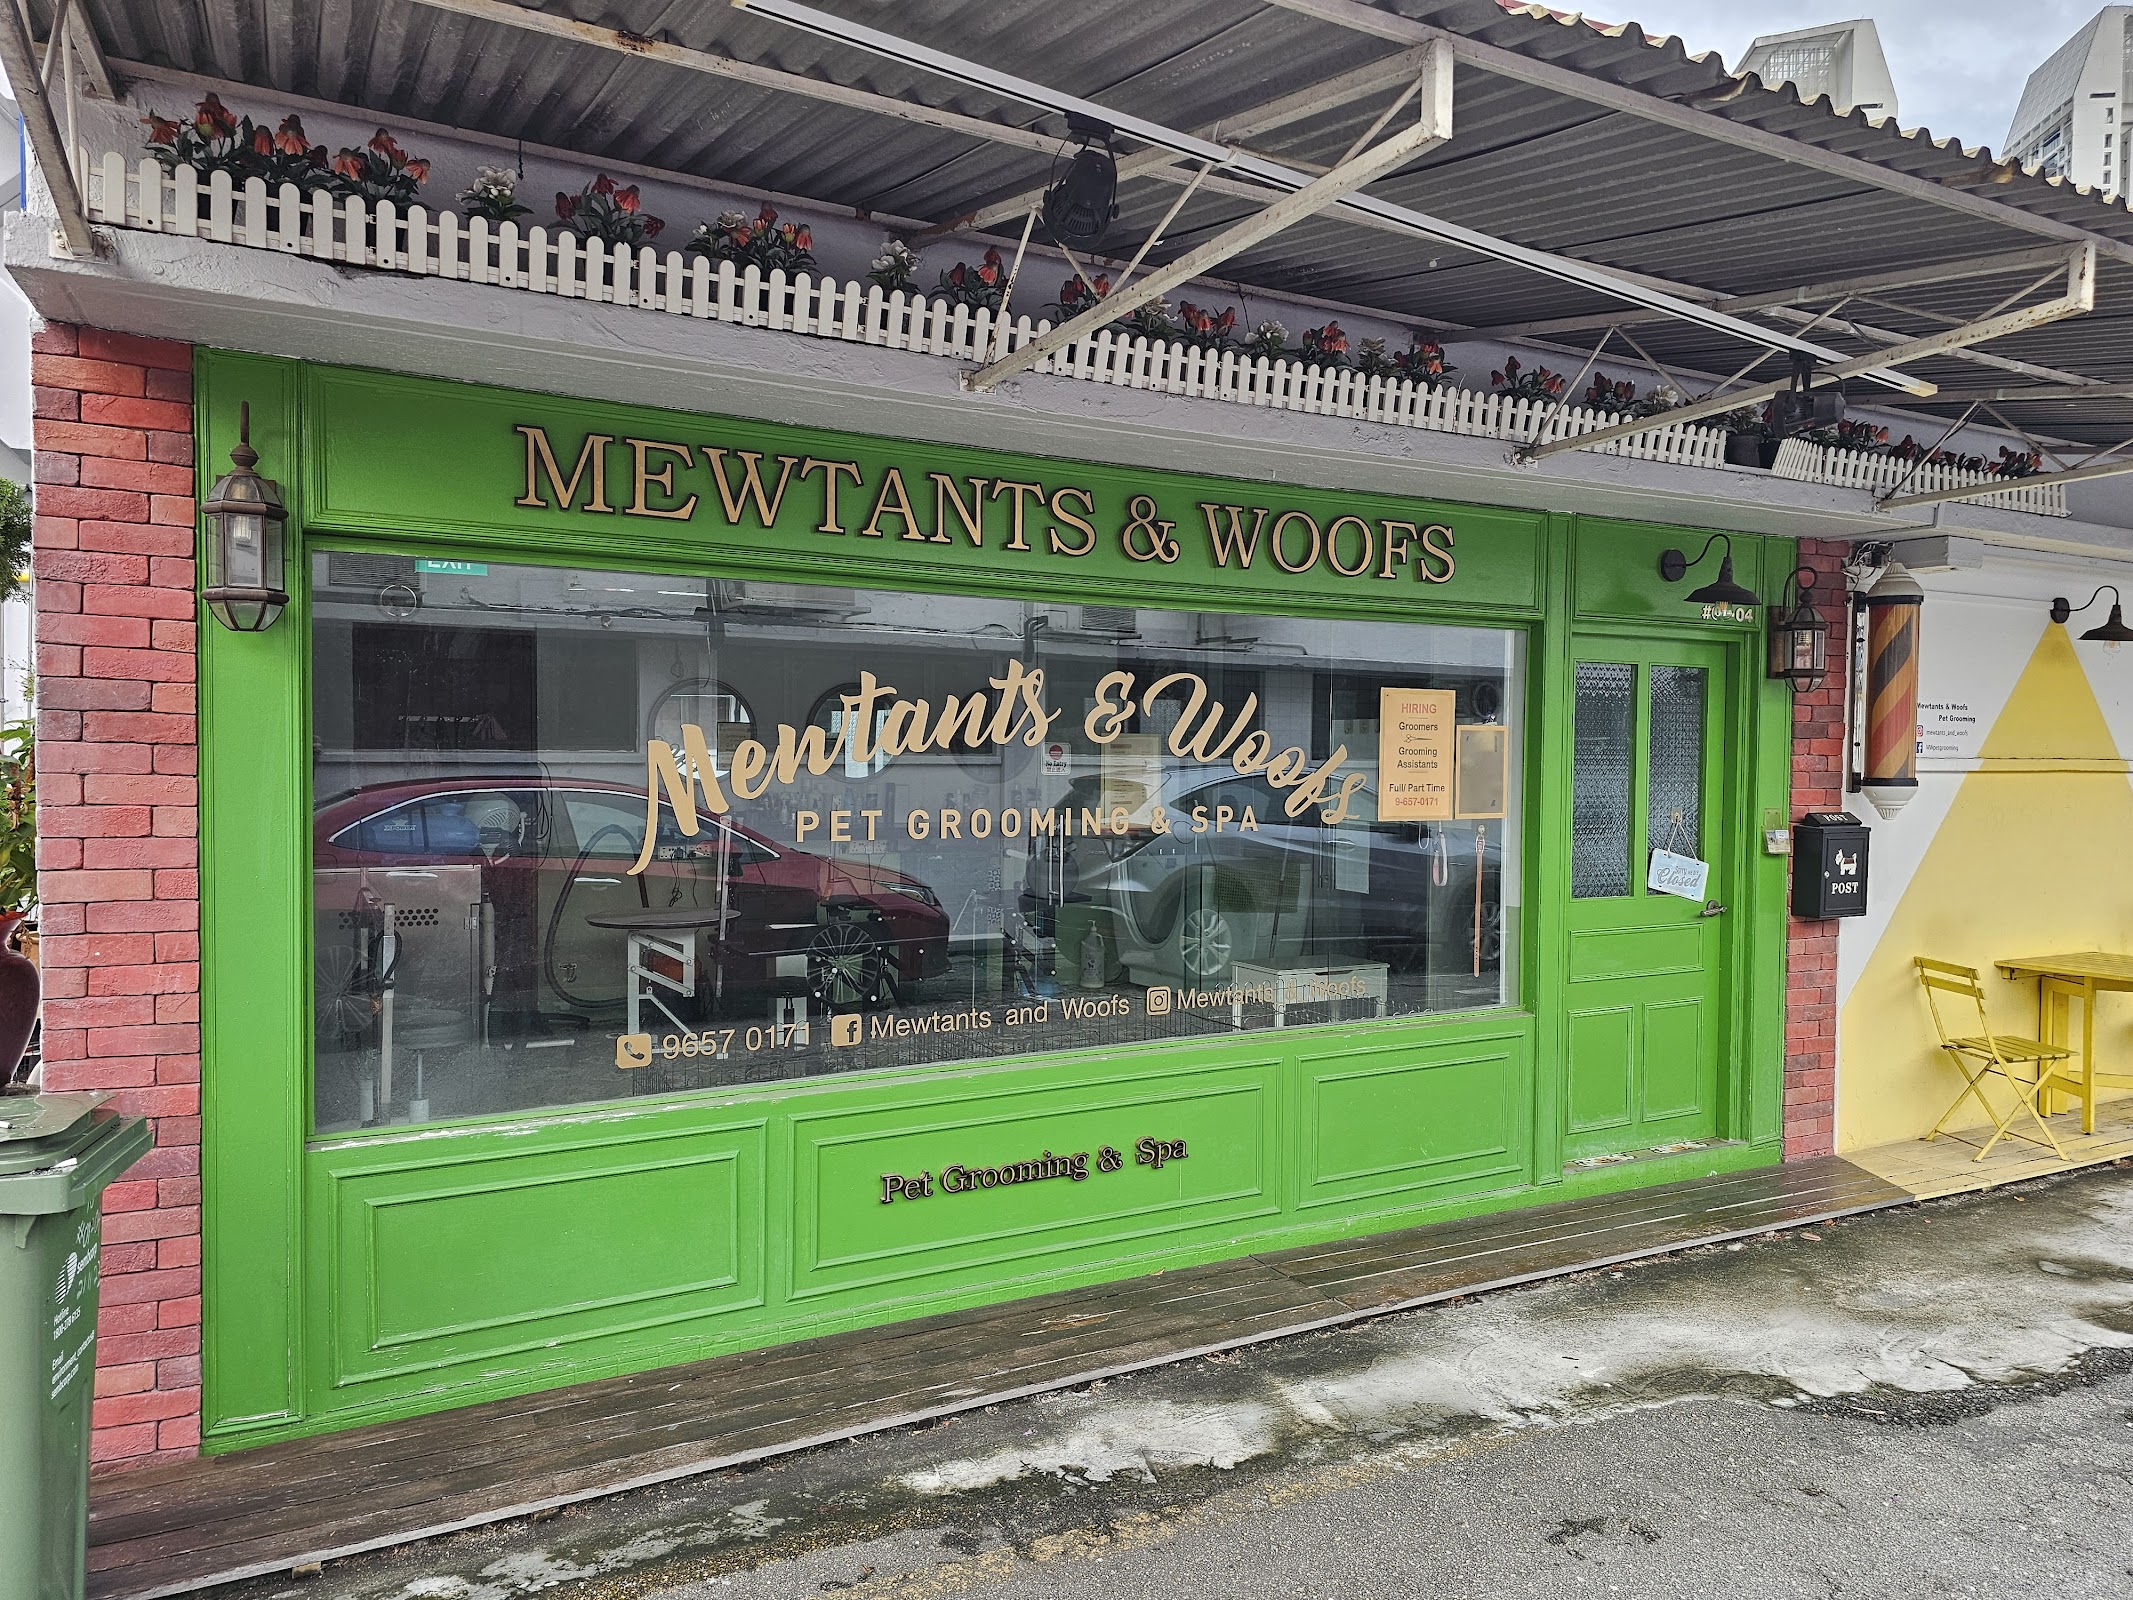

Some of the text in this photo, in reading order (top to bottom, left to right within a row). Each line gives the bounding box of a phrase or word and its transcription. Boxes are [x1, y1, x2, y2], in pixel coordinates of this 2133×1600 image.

[513, 424, 1457, 585] MEWTANTS & WOOFS
[1401, 703, 1437, 714] HIRING
[1951, 703, 1968, 711] Woofs
[1938, 714, 1976, 724] Pet Grooming
[1398, 721, 1439, 731] Groomers
[1398, 746, 1438, 757] Grooming
[626, 658, 1368, 877] Mewtants & Woofs
[1397, 760, 1439, 769] Assistants
[1389, 783, 1446, 793] Full/ Part Time
[1395, 797, 1439, 807] 9-657-0171
[796, 805, 1259, 843] PET GROOMING & SPA
[1822, 814, 1849, 822] POST
[1657, 867, 1702, 888] Closed
[1831, 882, 1859, 895] POST
[1177, 981, 1274, 1010] Mewtants
[1309, 975, 1366, 997] Woofs
[870, 994, 1131, 1039] Mewtants and Woofs
[662, 1021, 810, 1060] 9657 0171
[879, 1135, 1189, 1205] Pet Grooming & Spa
[52, 1350, 64, 1371] Email
